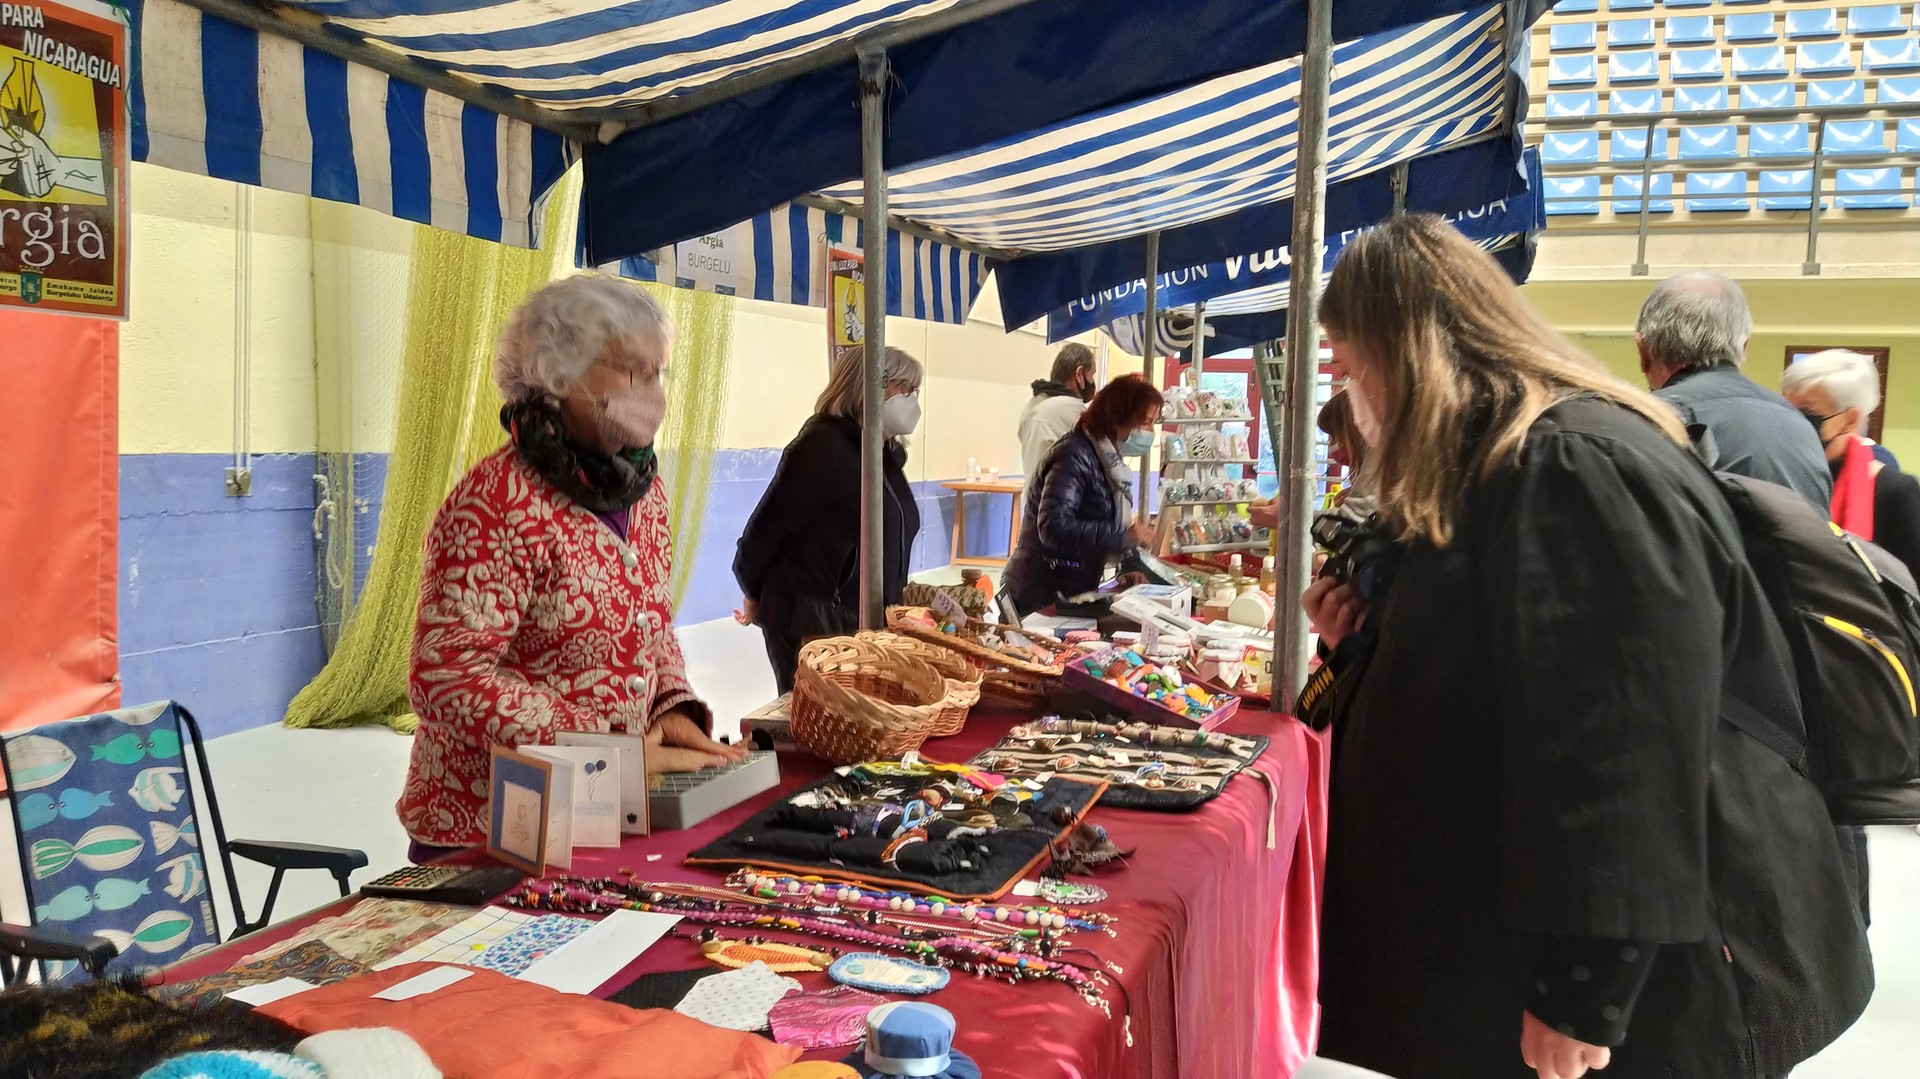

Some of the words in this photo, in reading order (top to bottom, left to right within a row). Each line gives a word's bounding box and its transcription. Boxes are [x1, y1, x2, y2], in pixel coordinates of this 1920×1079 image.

[2, 3, 45, 29] PARA
[23, 29, 121, 88] NICARAGUA
[688, 252, 732, 275] BURGELU
